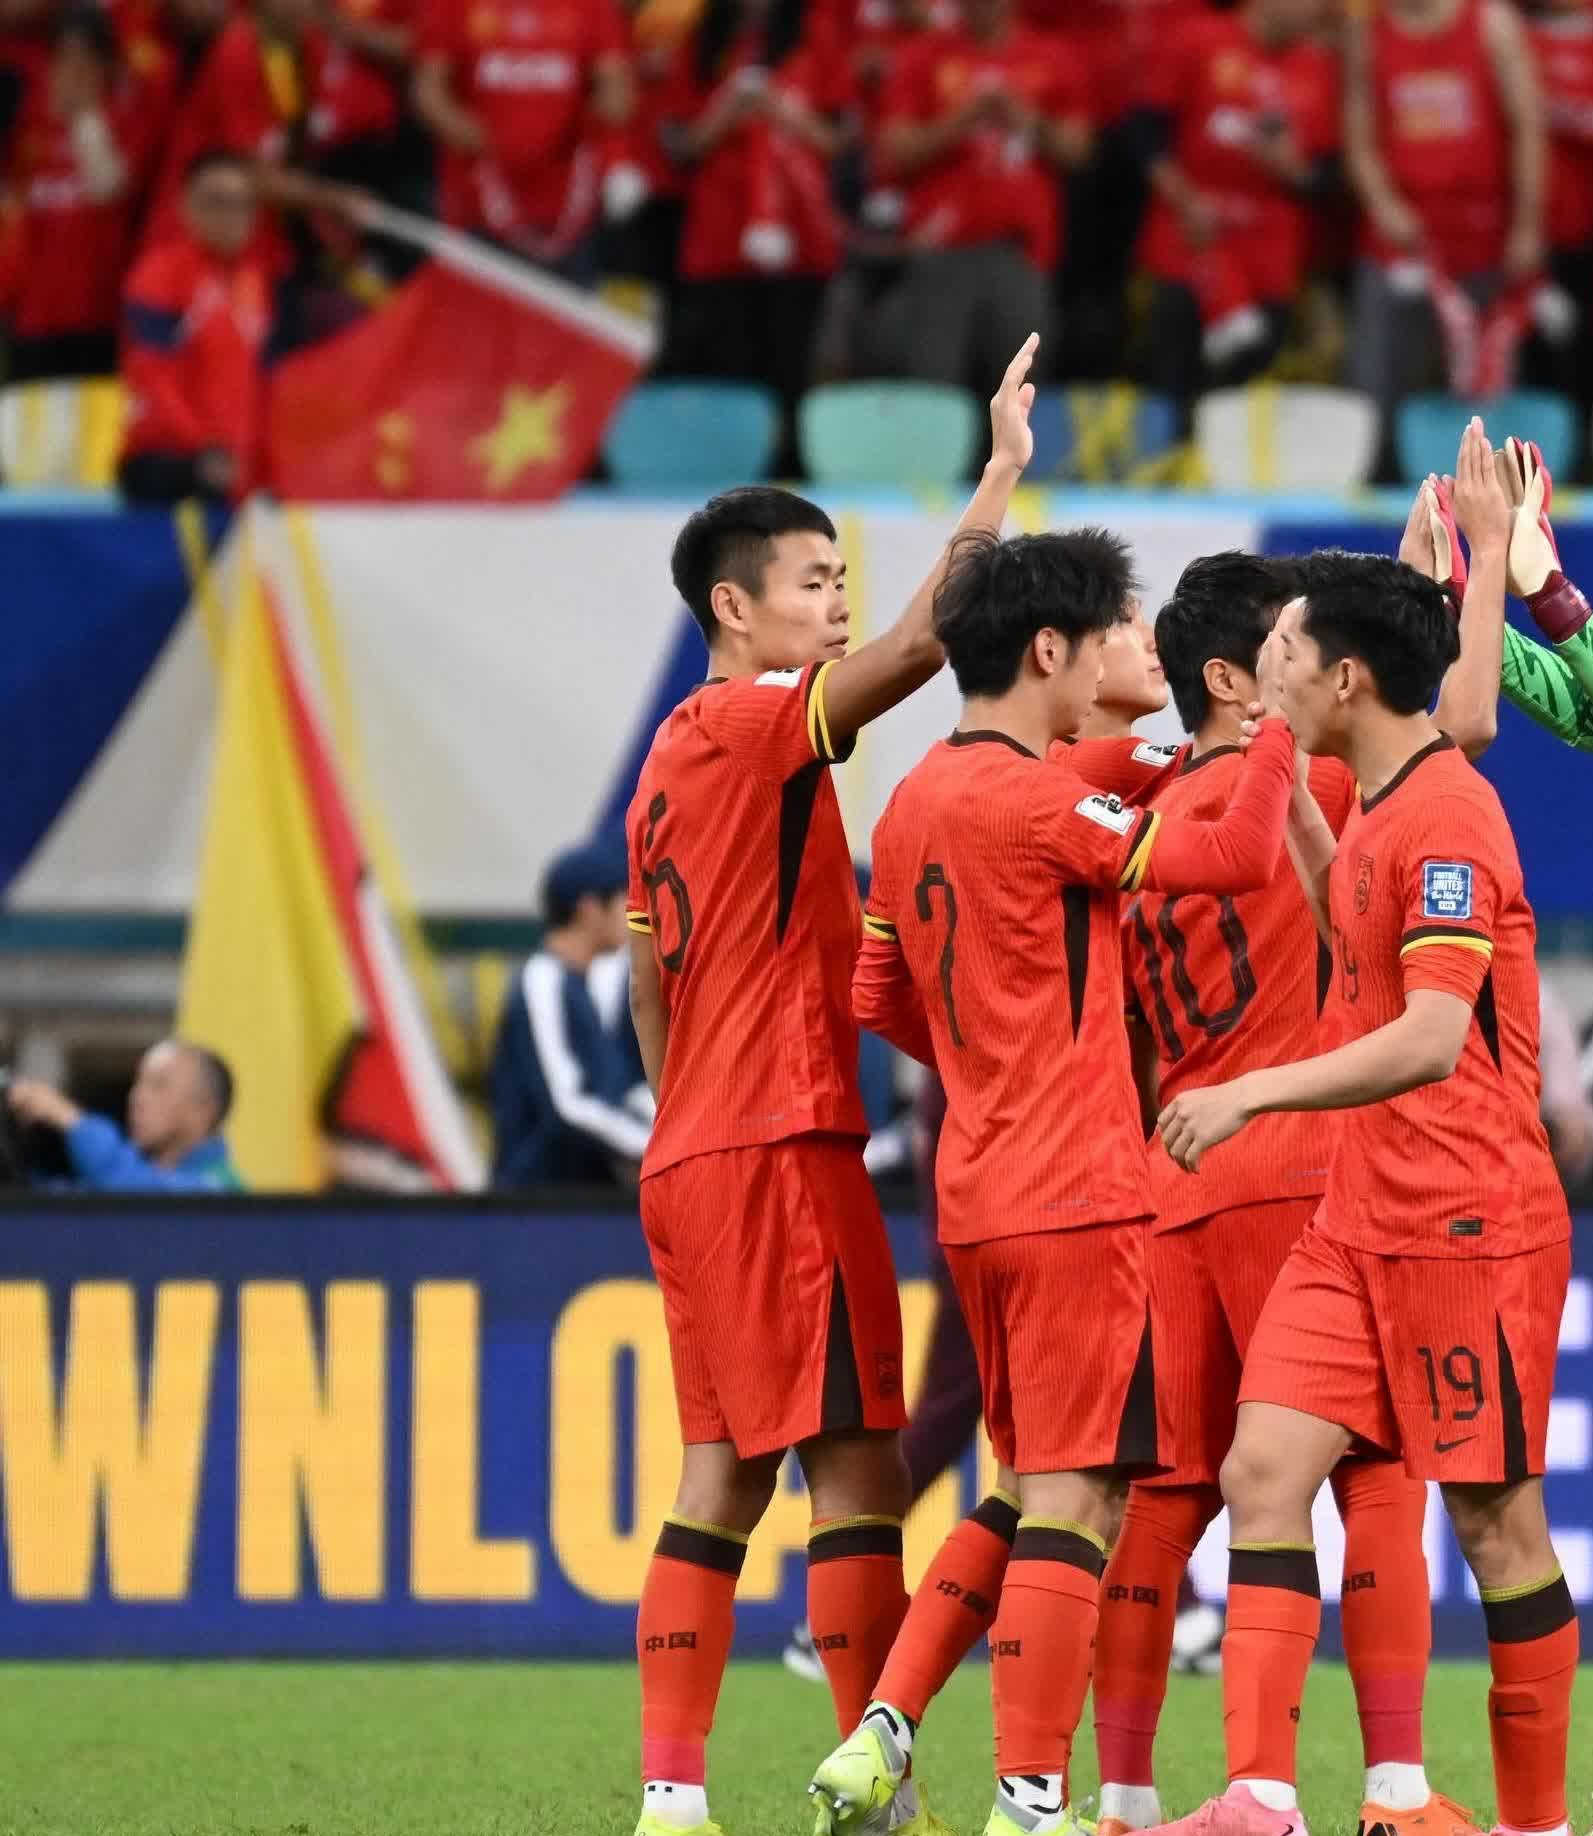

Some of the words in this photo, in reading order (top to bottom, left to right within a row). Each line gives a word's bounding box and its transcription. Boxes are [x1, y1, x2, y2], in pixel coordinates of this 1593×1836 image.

[641, 791, 693, 975] 6
[1432, 880, 1464, 891] UNITES
[915, 863, 968, 1048] 7
[1130, 894, 1258, 1064] 10
[1417, 1346, 1485, 1421] 19
[1107, 1584, 1160, 1608] 中国
[645, 1631, 697, 1652] 中国
